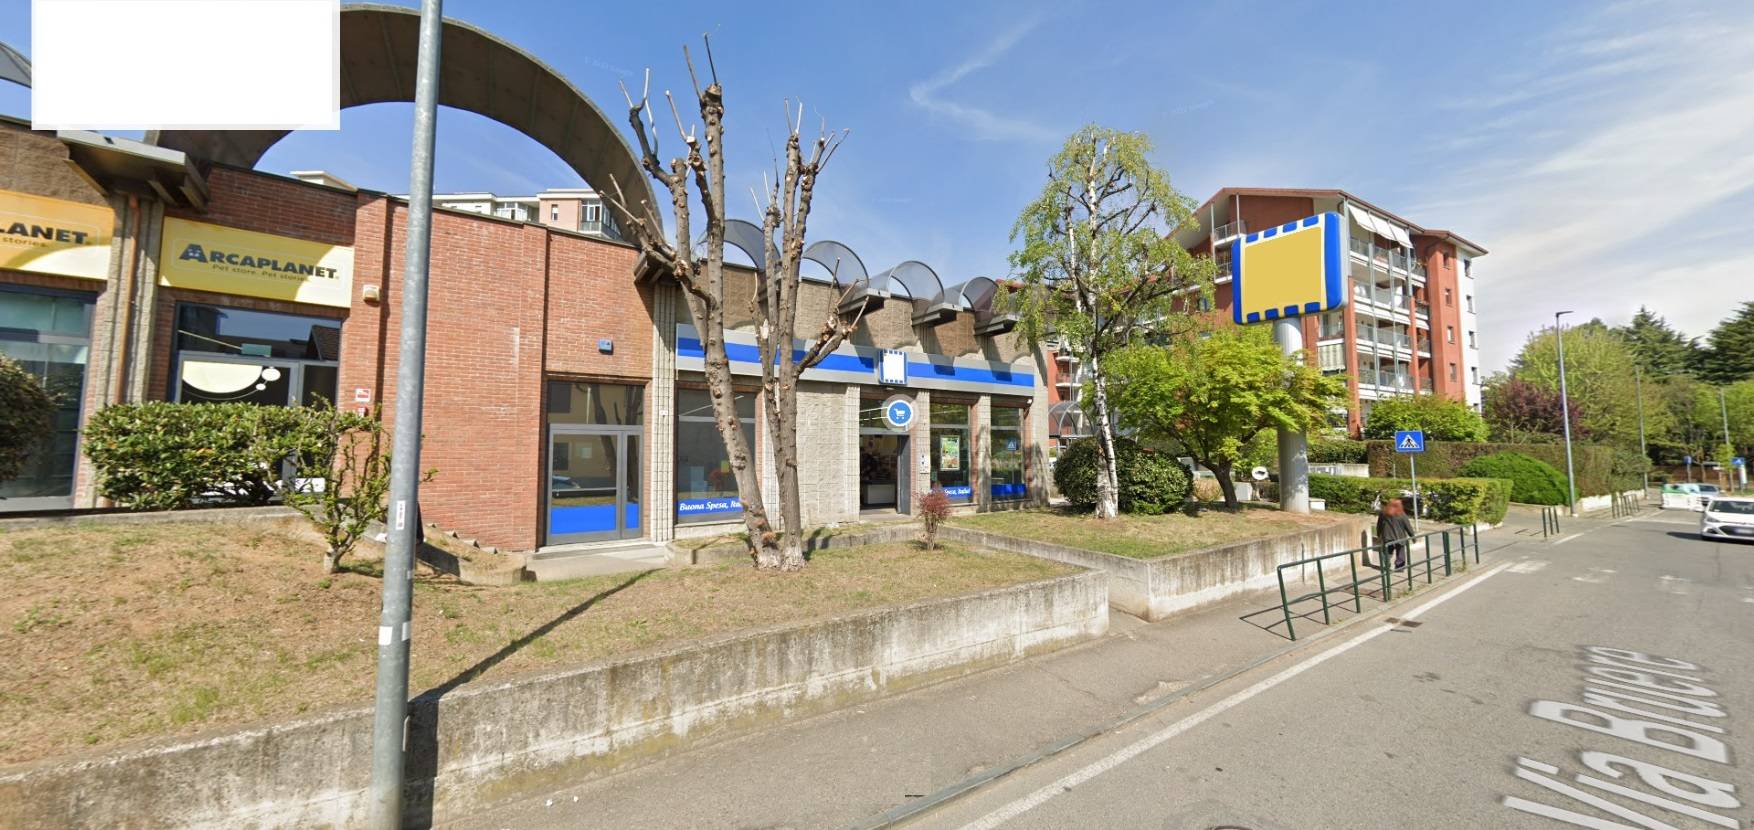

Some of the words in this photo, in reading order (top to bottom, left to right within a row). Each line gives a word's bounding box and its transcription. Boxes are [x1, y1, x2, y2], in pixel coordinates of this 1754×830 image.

[179, 243, 337, 279] ARCAPLANET
[680, 502, 704, 511] Buona
[1529, 645, 1729, 764] Bruere
[1503, 751, 1742, 830] Via
